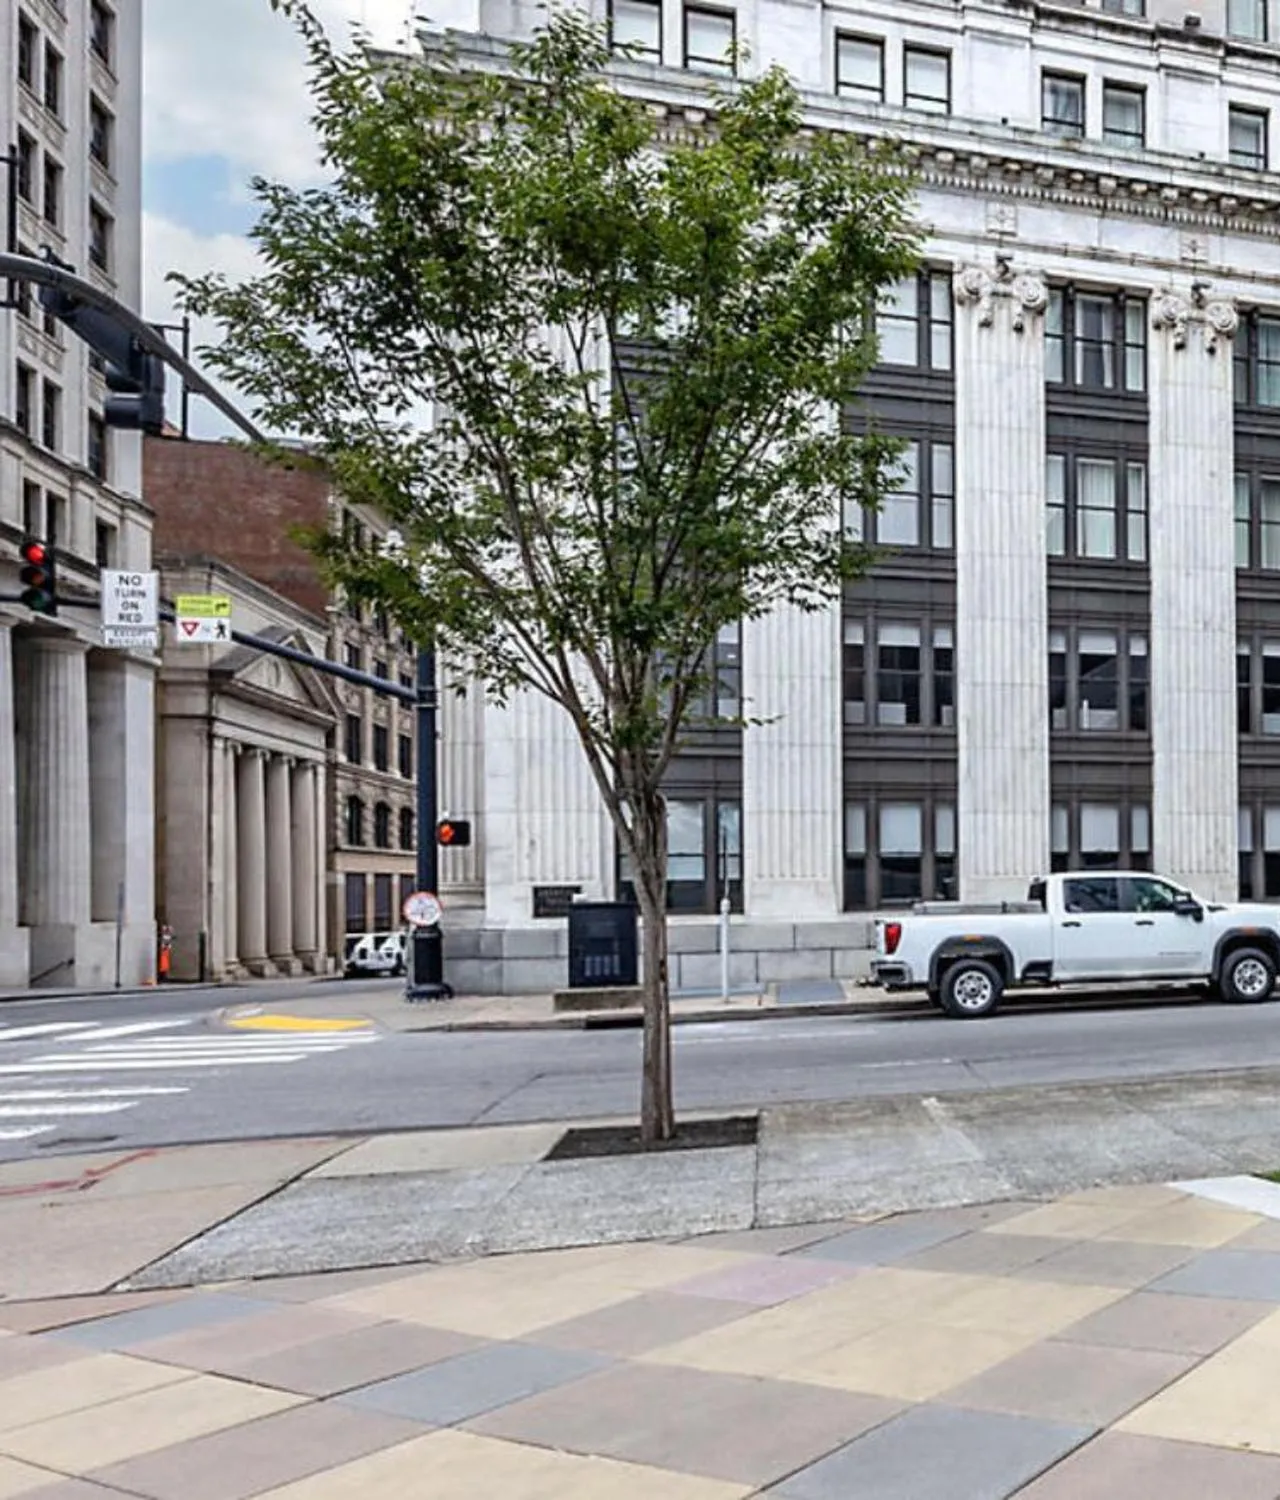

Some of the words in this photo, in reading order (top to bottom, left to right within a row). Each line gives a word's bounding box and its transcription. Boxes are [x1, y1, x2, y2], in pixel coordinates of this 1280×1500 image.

[118, 574, 142, 586] NO
[114, 587, 147, 599] TURN
[120, 600, 140, 611] ON
[118, 612, 143, 624] RED
